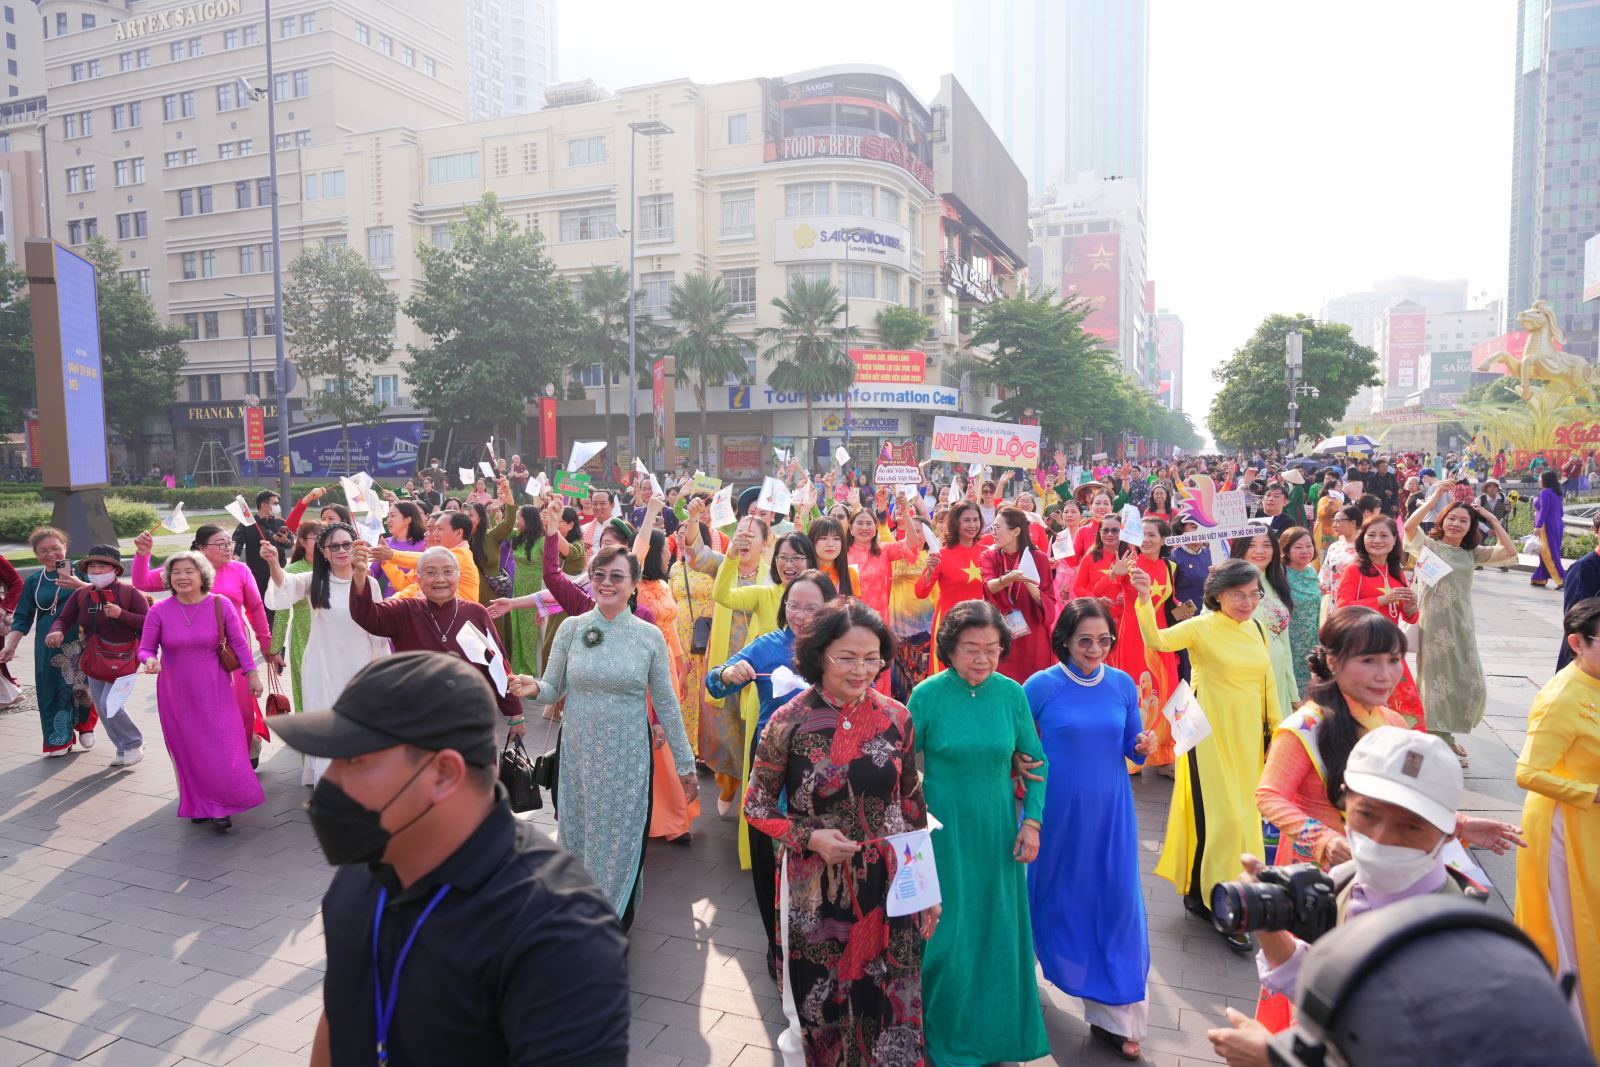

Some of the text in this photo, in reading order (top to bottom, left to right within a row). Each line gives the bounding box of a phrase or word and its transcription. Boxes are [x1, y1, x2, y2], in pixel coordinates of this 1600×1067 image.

[116, 0, 241, 40] ARTEX SAIGON
[784, 136, 815, 159] FOOD
[818, 139, 827, 154] &
[829, 134, 862, 157] BEER
[764, 390, 831, 404] Tourst
[836, 389, 930, 405] Information
[189, 406, 234, 420] FRANCK
[995, 435, 1037, 462] LỘC
[1166, 537, 1176, 545] CLB
[1207, 531, 1217, 541] VIỆT
[1218, 531, 1228, 540] NAM
[1254, 526, 1266, 535] MINH
